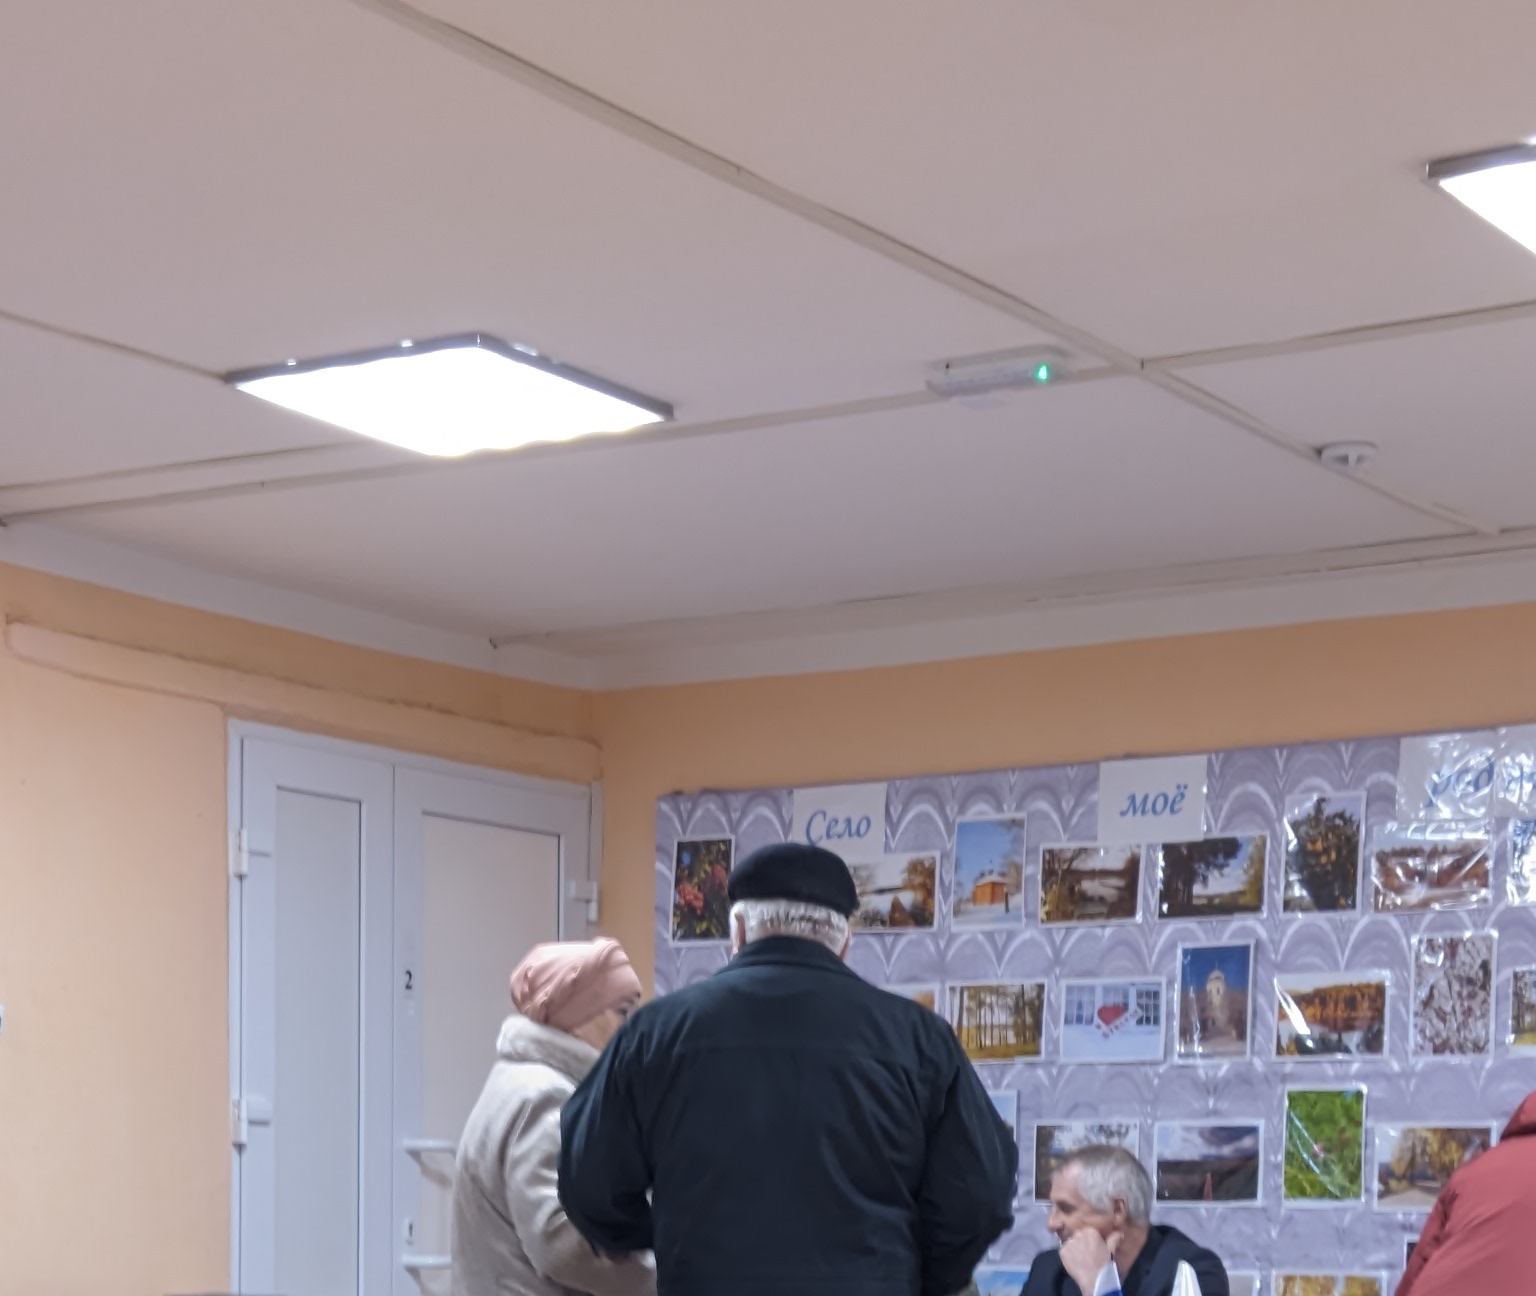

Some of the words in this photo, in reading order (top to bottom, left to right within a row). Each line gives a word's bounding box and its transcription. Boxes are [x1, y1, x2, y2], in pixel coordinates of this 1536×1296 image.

[805, 809, 871, 847] Село
[1119, 783, 1188, 817] моё
[404, 969, 413, 990] 2
